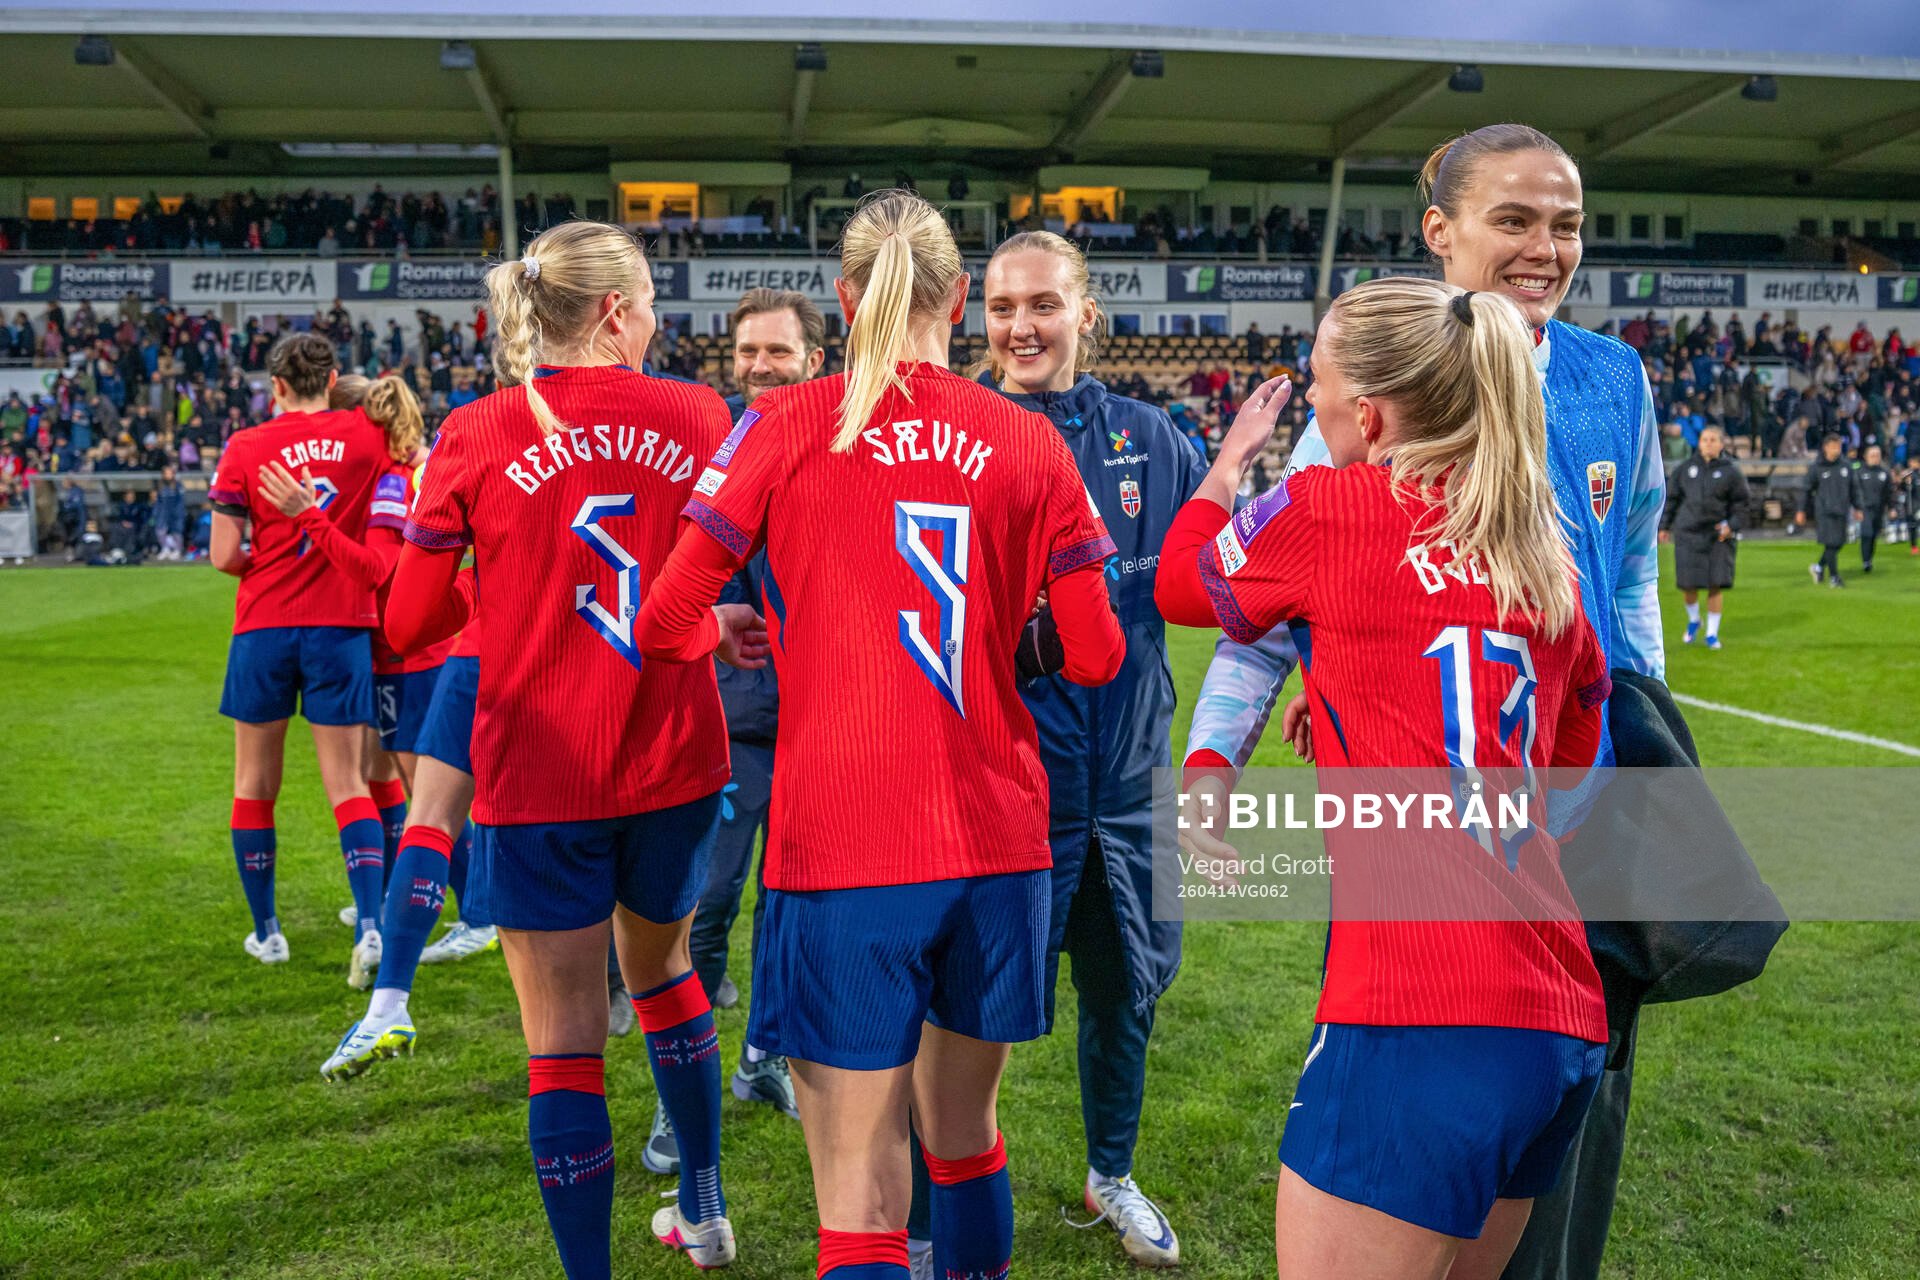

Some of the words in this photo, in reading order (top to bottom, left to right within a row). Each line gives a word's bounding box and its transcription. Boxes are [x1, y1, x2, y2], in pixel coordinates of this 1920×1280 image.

[61, 264, 154, 282] Romerike
[192, 265, 316, 295] #HEIERPÅ
[705, 264, 825, 295] #HEIERPÅ
[1222, 266, 1305, 283] Romerike
[1221, 284, 1304, 299] Sparebank
[1763, 277, 1859, 305] #HEIERPÅ
[281, 439, 345, 469] ENGEN
[862, 419, 993, 482] SÆVIK
[1121, 555, 1160, 574] teleno
[570, 494, 642, 673] 5
[894, 500, 970, 720] 9
[1422, 626, 1537, 874] 17
